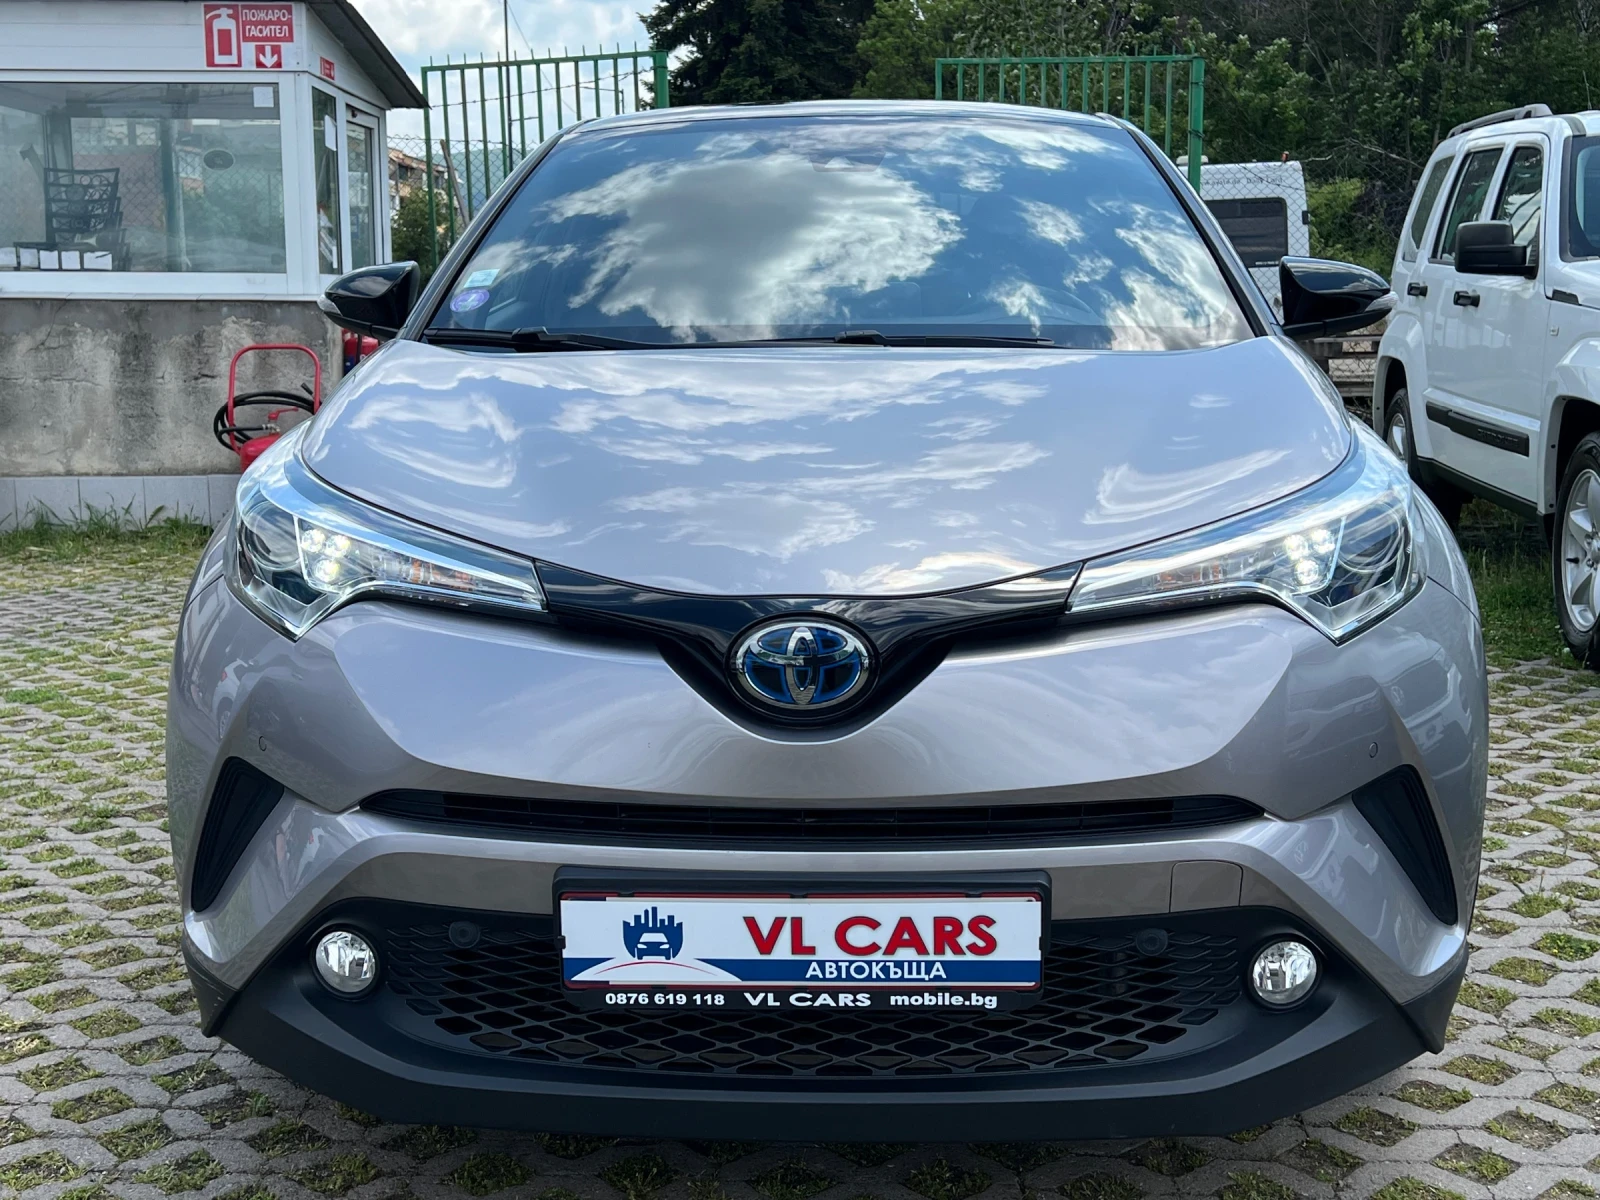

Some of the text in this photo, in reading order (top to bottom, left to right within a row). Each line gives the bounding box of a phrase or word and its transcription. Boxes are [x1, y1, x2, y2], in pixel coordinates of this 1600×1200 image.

[242, 9, 292, 21] ПОЖАРО-
[245, 25, 289, 37] ГАСИТЕЛ
[743, 915, 998, 956] VL CARS
[805, 961, 947, 981] АВТОКЪЩА
[605, 993, 998, 1009] 0876 619 118 VL CARS mobile.bg
